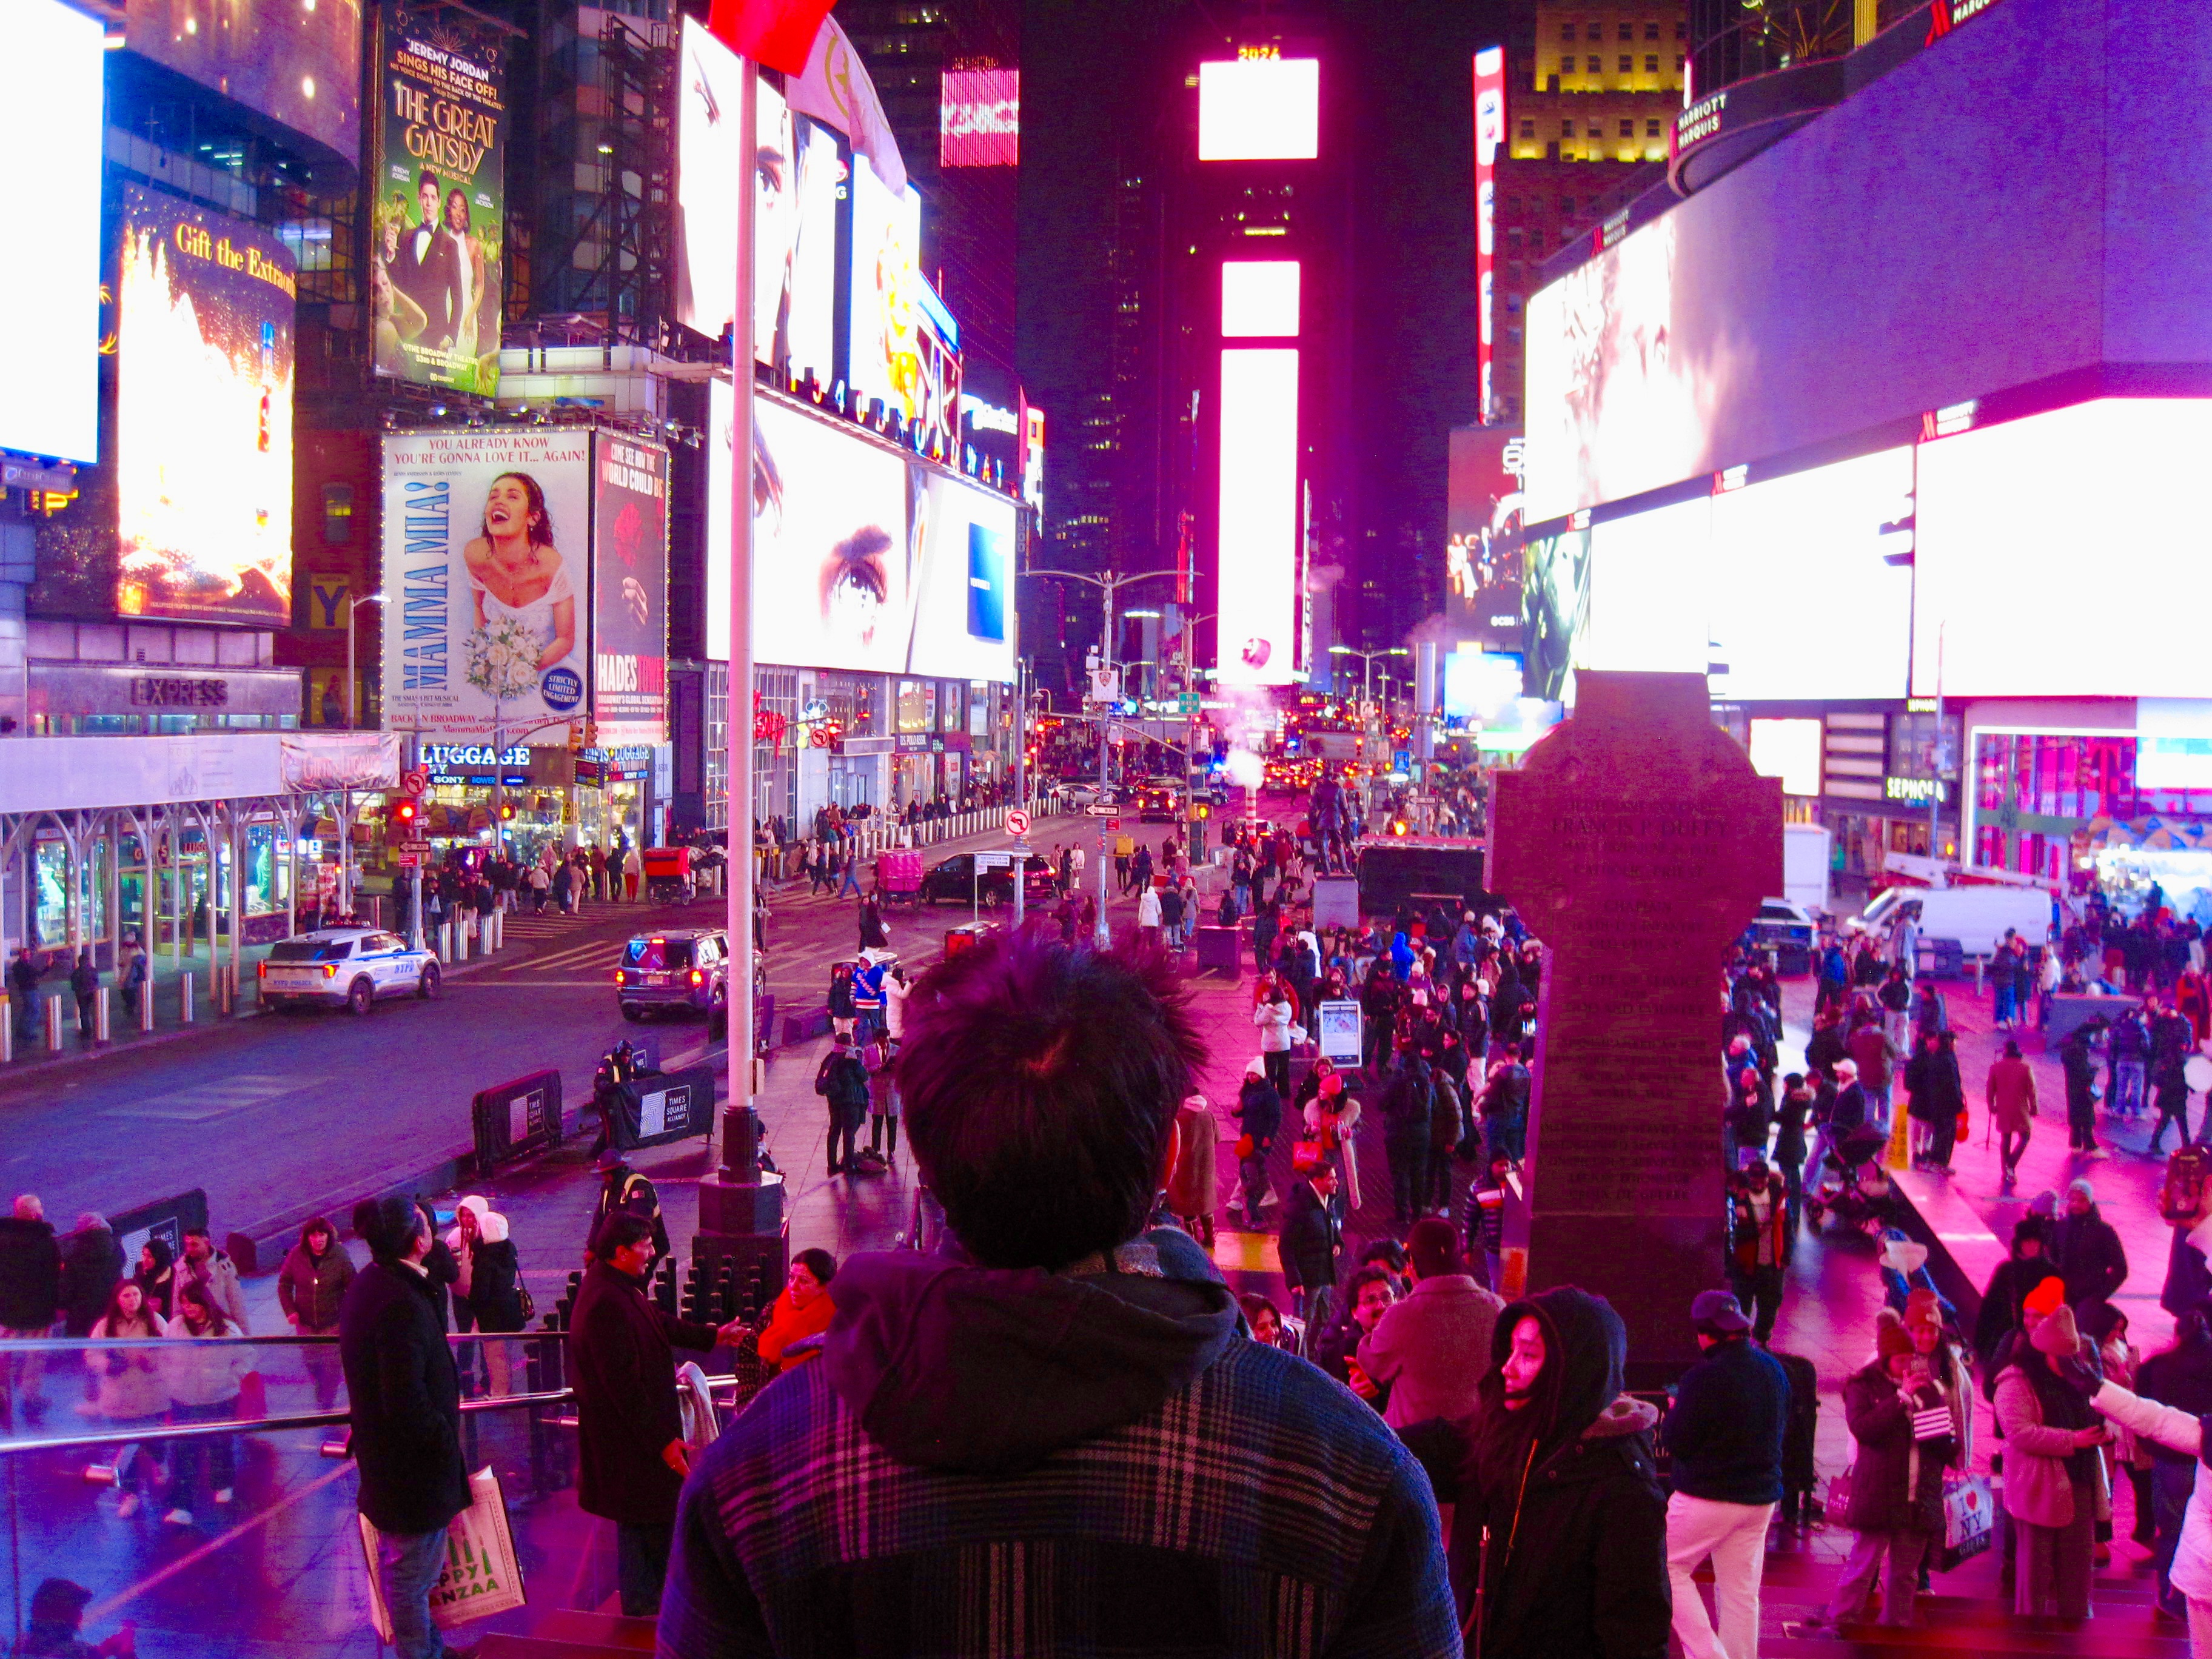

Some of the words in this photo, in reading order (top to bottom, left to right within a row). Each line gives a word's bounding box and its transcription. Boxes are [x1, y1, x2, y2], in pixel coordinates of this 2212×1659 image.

[396, 50, 429, 73] SINGS
[430, 64, 448, 81] HIS
[450, 70, 474, 92] FACE
[475, 82, 498, 101] OFF!
[450, 57, 489, 82] JORDAN
[452, 85, 464, 96] BACK
[465, 91, 472, 99] OF
[396, 84, 430, 126] THE
[432, 99, 497, 149] GREAT
[1678, 93, 1727, 132] MARRIOTT
[1678, 115, 1719, 150] MARQUIS
[404, 123, 484, 175] GATSBY
[419, 162, 426, 170] A
[426, 164, 443, 175] NEW
[443, 170, 472, 186] MUSICAL
[835, 186, 847, 200] G
[176, 223, 213, 261] Gift
[216, 238, 245, 272] the
[420, 347, 453, 360] BROADWAY
[454, 354, 479, 366] THEATRE
[436, 360, 469, 372] BROADWAY
[429, 438, 452, 450] YOU
[456, 438, 510, 449] ALREADY
[514, 437, 550, 448] KNOW
[395, 453, 435, 464] YOU'RE
[439, 452, 481, 463] GONNA
[486, 451, 515, 463] LOVE
[519, 451, 539, 462] IT...
[543, 450, 585, 461] AGAIN!
[611, 443, 625, 464] COME
[625, 446, 635, 466] SEE
[646, 453, 655, 472] THE
[602, 460, 628, 488] WORLD
[629, 469, 654, 495] COULD
[653, 477, 664, 498] BE
[403, 481, 451, 555] MIA!
[313, 586, 348, 626] Y
[403, 564, 449, 691] MAMMA
[548, 674, 578, 687] STRICTLY
[548, 683, 576, 695] LIMITED
[130, 678, 229, 706] EXPRESS
[543, 689, 580, 703] ENGAGEMENT
[625, 695, 641, 705] GLOBAL
[391, 714, 414, 723] BACK
[431, 714, 477, 723] BROADWAY
[420, 746, 531, 766] LUGGAGE
[614, 746, 650, 761] LUGGAGE
[434, 776, 466, 784] SONY
[471, 776, 496, 785] BOWER
[1886, 777, 1945, 802] SEPHORA
[1552, 817, 1633, 834] FRANCIS
[1661, 819, 1729, 837] DUFFY
[1604, 900, 1671, 913] CHAPLAIN
[395, 960, 414, 974] NYPD
[666, 1104, 688, 1116] SQUARE
[669, 1095, 686, 1106] TIMES
[1959, 1496, 1968, 1517] I
[1959, 1510, 1982, 1542] NY
[439, 1564, 478, 1587] PPY
